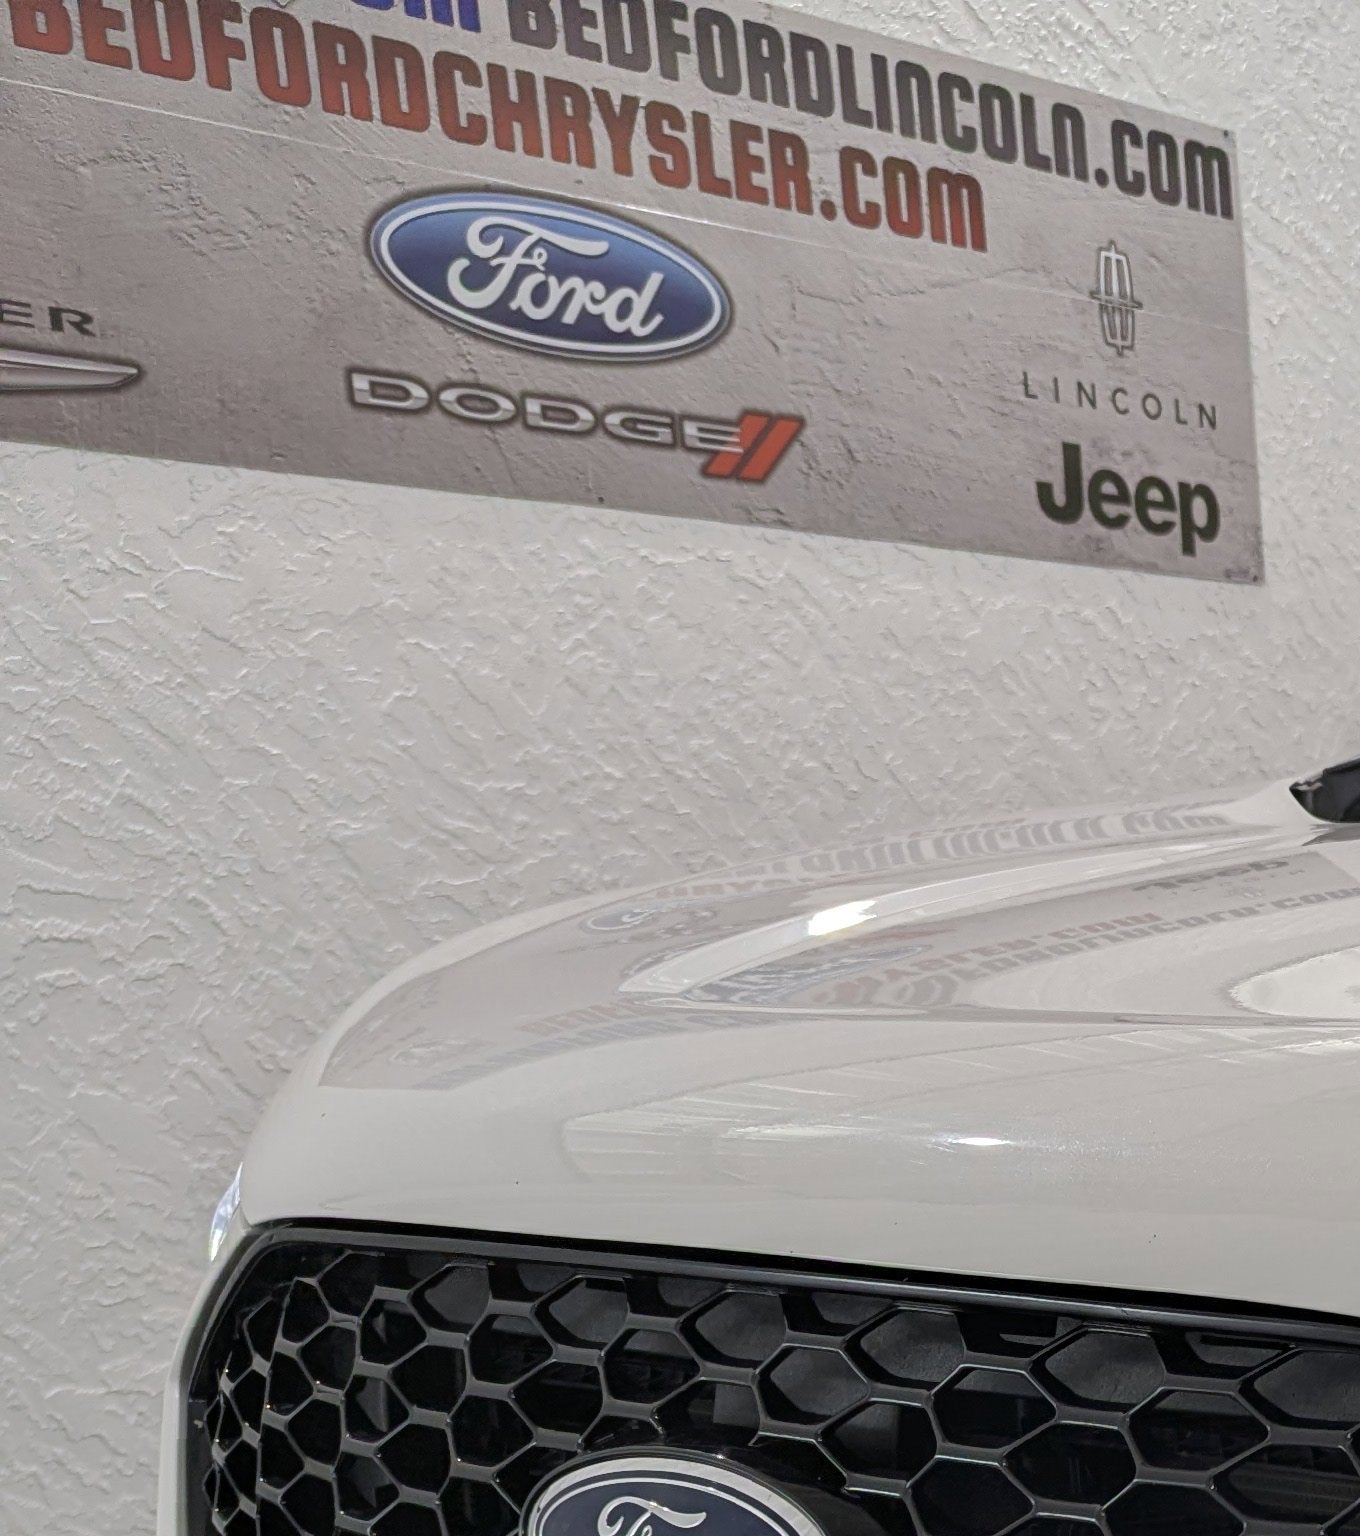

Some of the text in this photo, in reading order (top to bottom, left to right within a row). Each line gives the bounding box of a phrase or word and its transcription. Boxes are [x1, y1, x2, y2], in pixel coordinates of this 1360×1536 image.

[447, 215, 664, 338] Ford
[350, 371, 744, 455] DODGE
[1022, 371, 1217, 430] LINCOLN
[1036, 441, 1220, 556] Jeep
